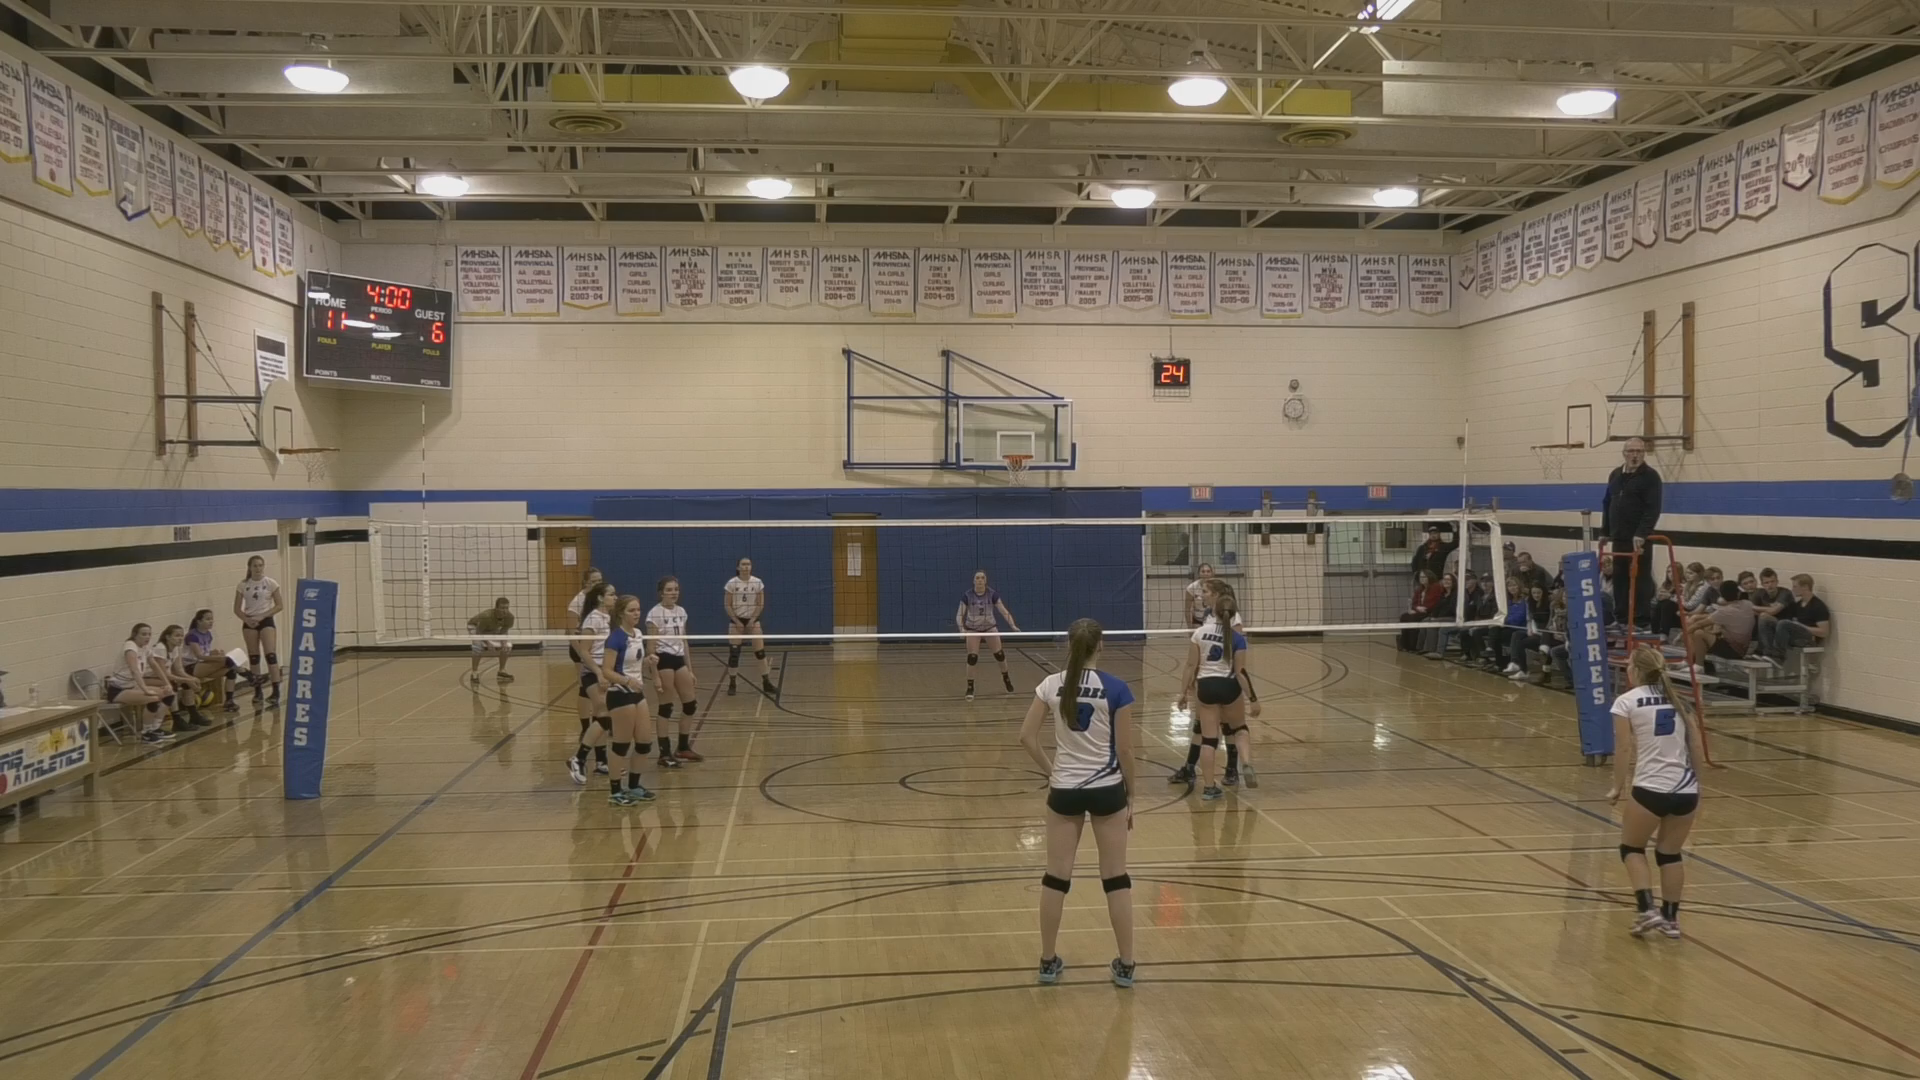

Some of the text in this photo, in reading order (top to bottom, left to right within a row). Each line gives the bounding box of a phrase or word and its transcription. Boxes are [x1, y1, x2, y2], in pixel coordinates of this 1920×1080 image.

[315, 297, 347, 309] HOME
[367, 284, 411, 310] 4:00
[371, 306, 393, 315] PERIOD
[415, 309, 446, 321] GUEST
[432, 322, 445, 343] 6
[318, 337, 337, 345] FOULS
[372, 343, 392, 351] PLAYER
[1824, 243, 1909, 447] S
[315, 369, 338, 377] POINTS
[371, 374, 391, 382] MATCH
[1161, 364, 1184, 383] 24
[1581, 578, 1605, 705] SABRES
[293, 608, 317, 746] SABRES
[1654, 708, 1676, 737] 5
